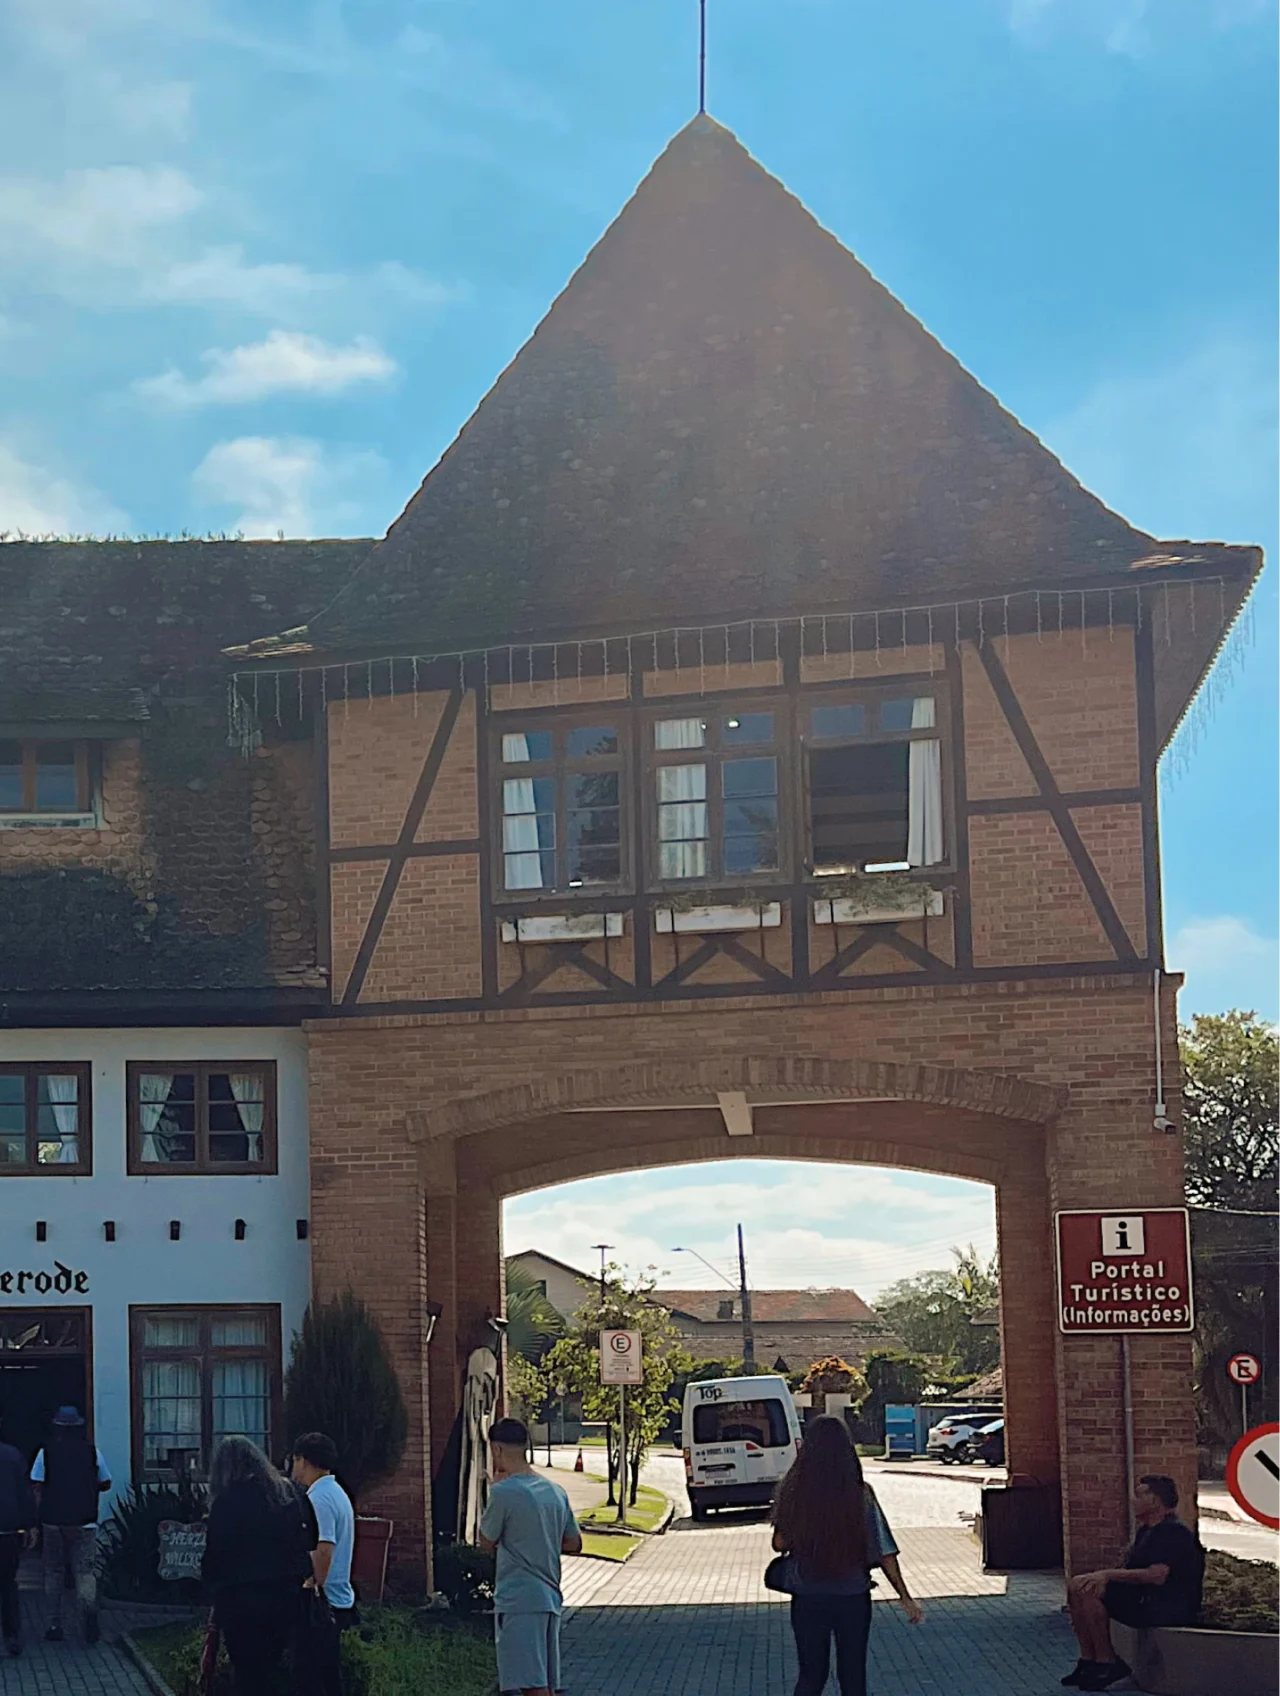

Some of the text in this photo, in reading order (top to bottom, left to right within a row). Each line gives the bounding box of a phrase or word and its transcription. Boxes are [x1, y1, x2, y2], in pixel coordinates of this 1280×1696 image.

[1091, 1260, 1164, 1279] Portal
[1070, 1282, 1180, 1302] Turístico
[1062, 1303, 1190, 1327] (Informações)
[616, 1337, 626, 1350] E
[1237, 1359, 1251, 1378] E
[696, 1385, 723, 1401] Top
